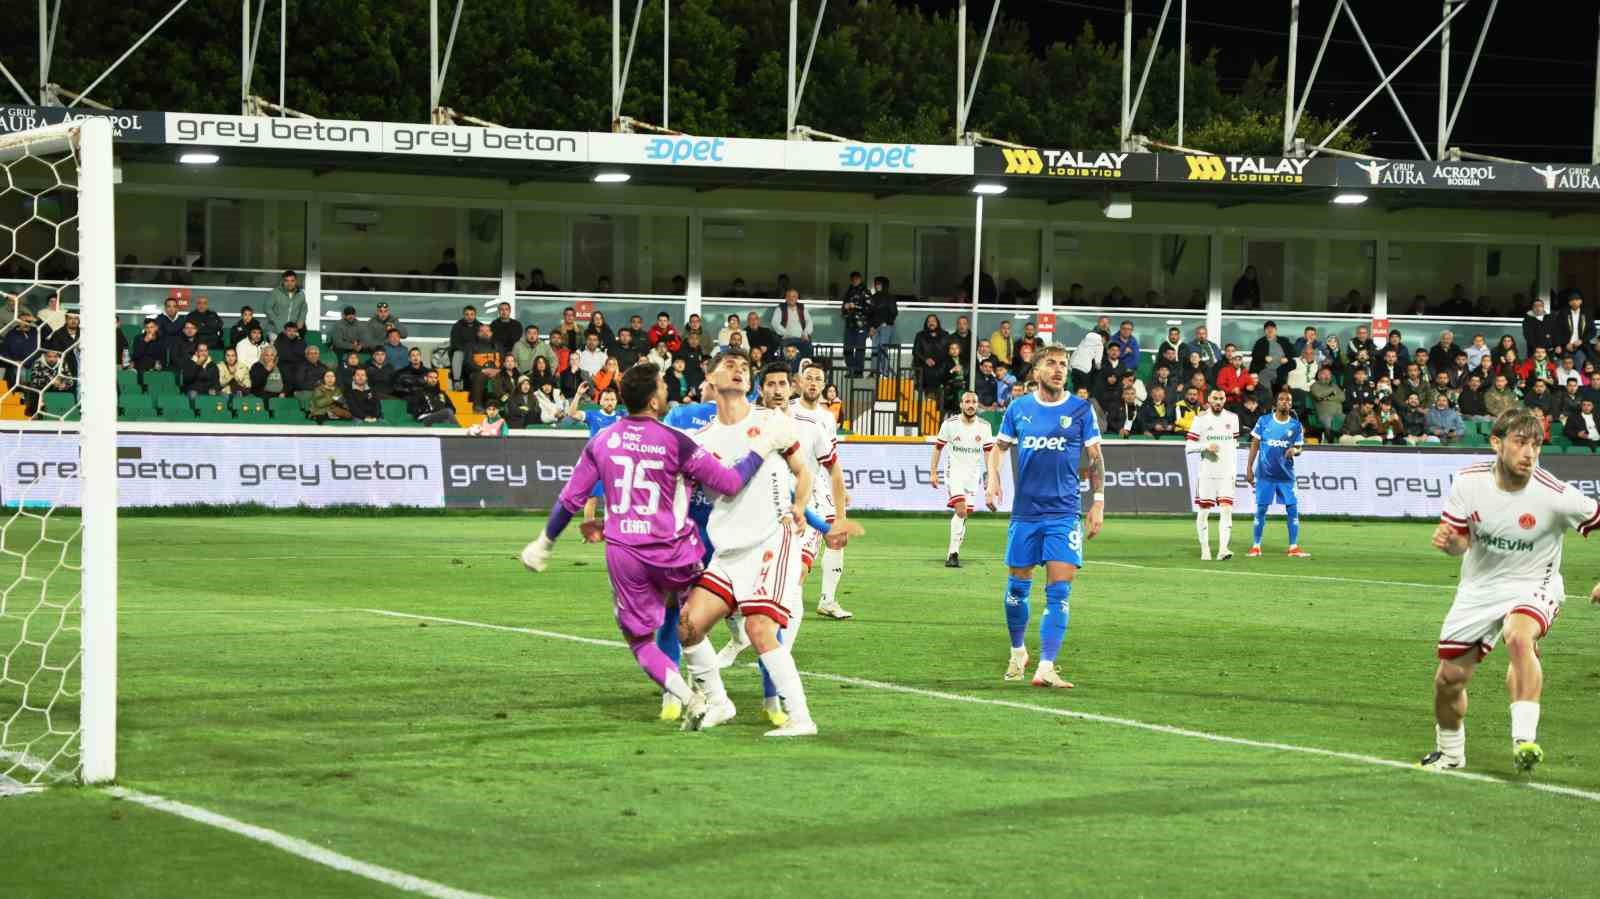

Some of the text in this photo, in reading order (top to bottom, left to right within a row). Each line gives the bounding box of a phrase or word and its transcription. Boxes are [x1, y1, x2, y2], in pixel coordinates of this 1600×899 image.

[8, 108, 36, 117] GRUP
[63, 111, 142, 130] APOL
[177, 117, 370, 143] grey beton
[394, 128, 576, 153] grey beton
[646, 137, 725, 164] opet
[839, 145, 917, 171] opet
[1044, 150, 1129, 169] TALAY
[1048, 168, 1122, 178] LOGISTICS
[1226, 156, 1310, 175] TALAY
[1392, 162, 1415, 171] GRUP
[1432, 165, 1496, 181] ACROPOL
[1568, 167, 1591, 176] GRUP
[1231, 174, 1304, 184] LOGISTICS
[1383, 170, 1426, 185] AURA
[1559, 175, 1600, 190] AURA
[623, 442, 667, 455] HOLDING
[1021, 435, 1068, 451] opet
[17, 458, 217, 484] gre beton
[240, 458, 429, 486] grey beton
[450, 464, 528, 487] grey
[843, 468, 906, 490] grey
[609, 455, 665, 516] 35
[1296, 471, 1358, 491] eton
[1375, 474, 1442, 498] grey
[1068, 530, 1082, 551] 9
[760, 565, 770, 583] 4
